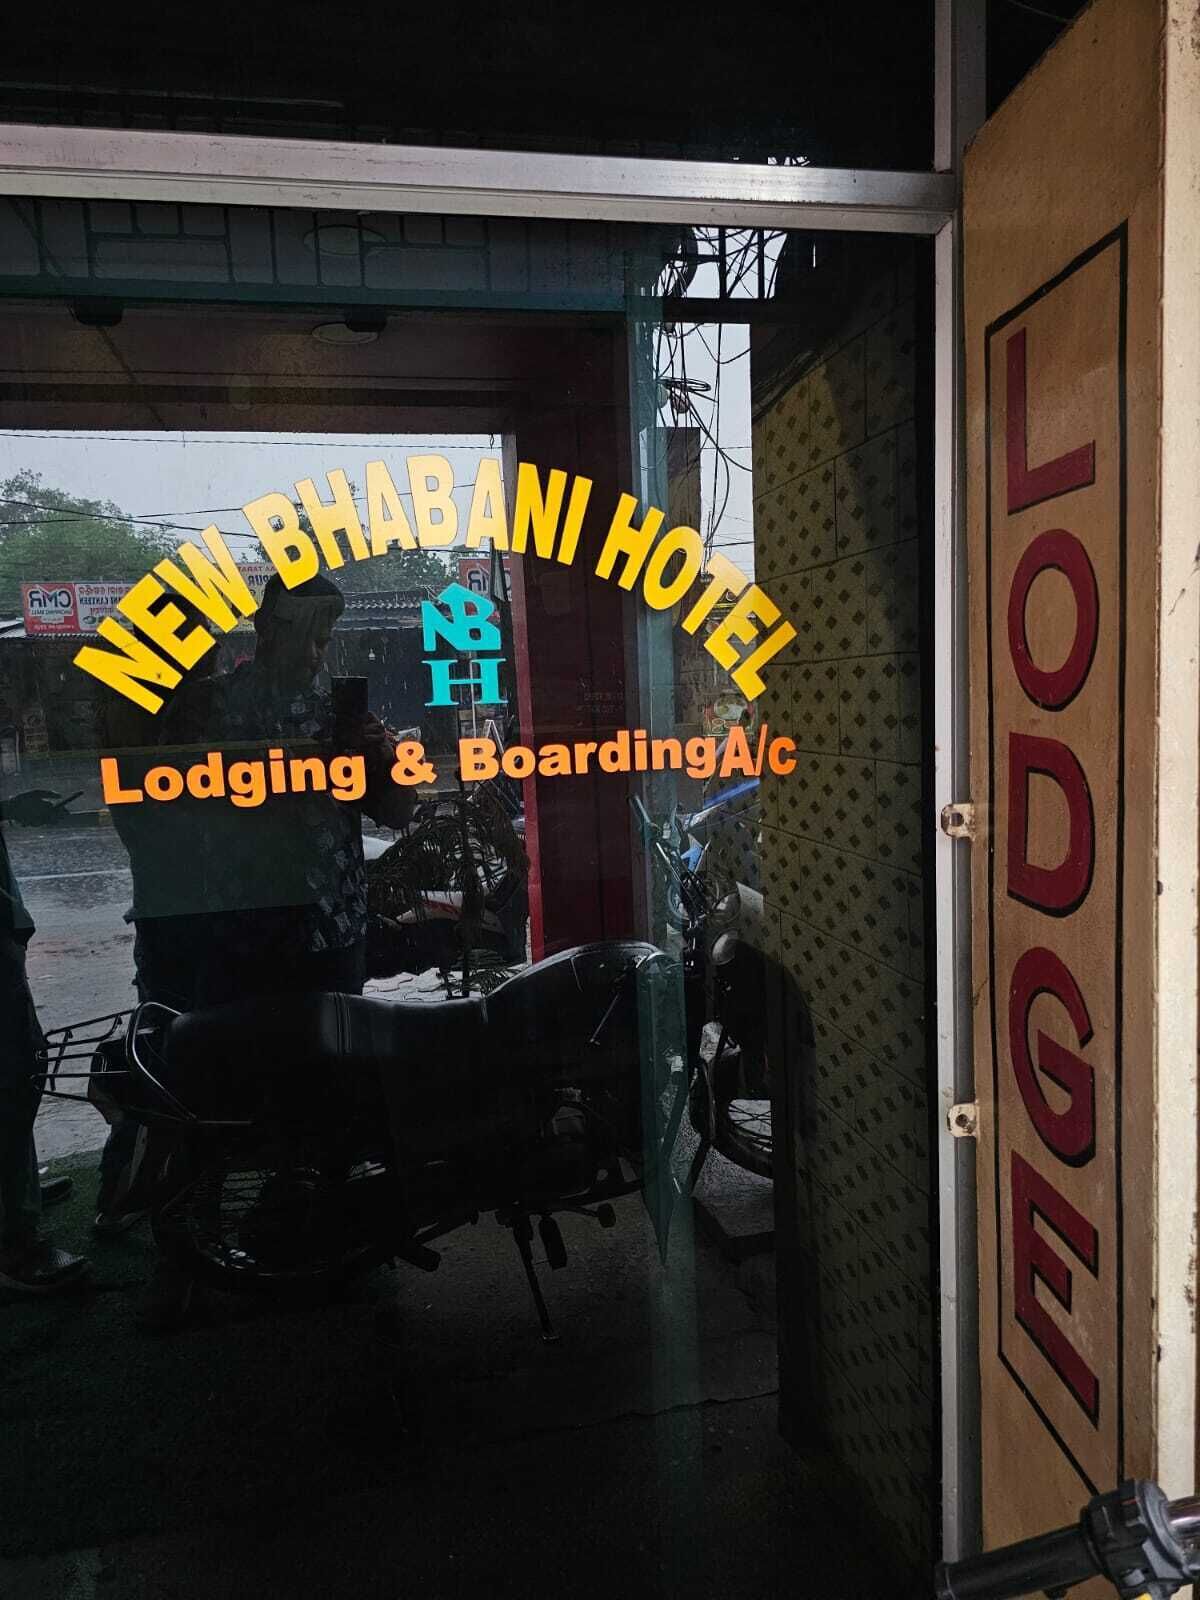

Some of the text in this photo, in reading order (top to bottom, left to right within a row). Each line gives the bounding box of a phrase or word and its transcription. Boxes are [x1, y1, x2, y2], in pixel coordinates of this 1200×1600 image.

[73, 455, 798, 715] NEW BHABANI HOTEL
[101, 750, 366, 807] Lodging
[391, 741, 437, 785] &
[1006, 326, 1099, 1429] LODGE
